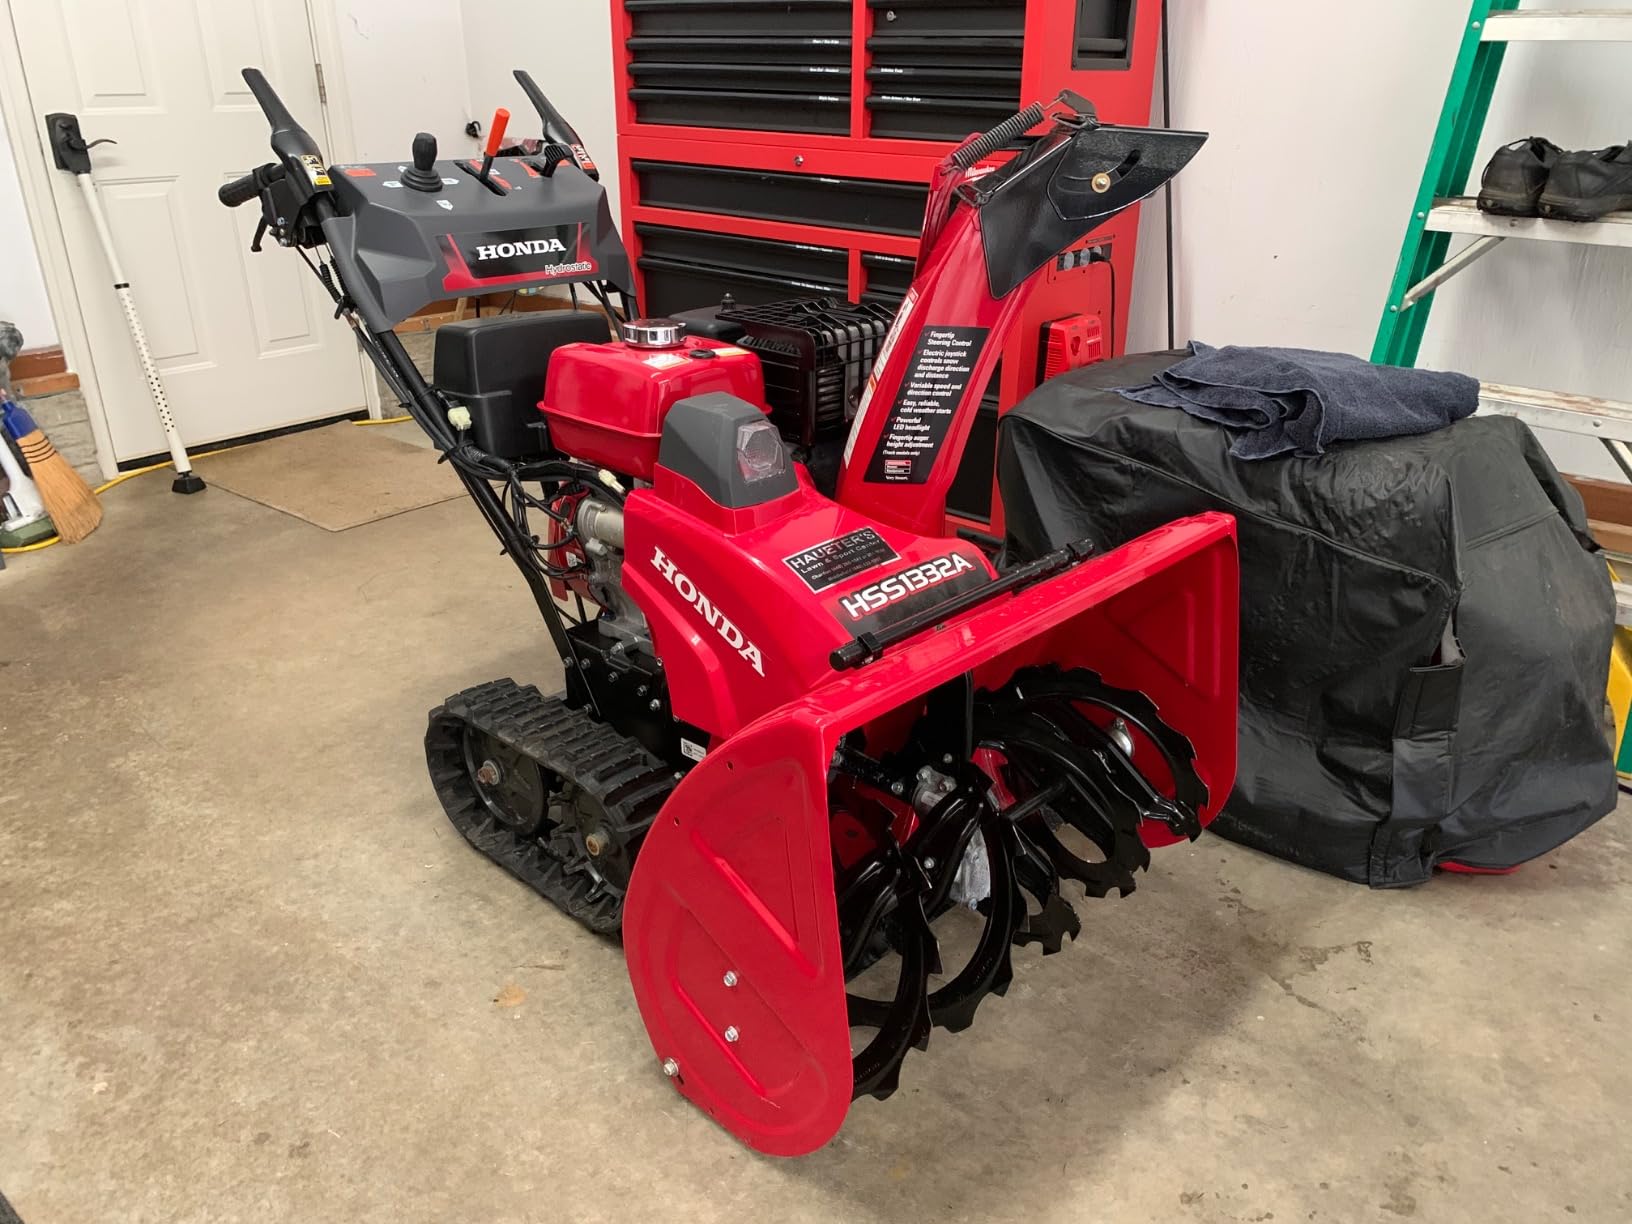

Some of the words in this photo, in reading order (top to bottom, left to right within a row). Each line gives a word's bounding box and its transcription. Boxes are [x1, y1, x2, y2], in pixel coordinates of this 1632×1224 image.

[476, 238, 566, 260] HONDA
[545, 261, 592, 276] Hydrostatic
[930, 331, 955, 339] Fingertip
[928, 339, 950, 347] Steering
[944, 350, 967, 358] joystick
[917, 364, 944, 372] discharge
[903, 399, 917, 407] Easy,
[905, 424, 930, 432] headlight
[790, 531, 875, 568] HAUETER'S
[801, 561, 824, 574] Lawn
[834, 549, 855, 560] Sport
[856, 540, 880, 551] Center
[842, 553, 973, 618] HSS1332A
[650, 546, 765, 677] HONDA
